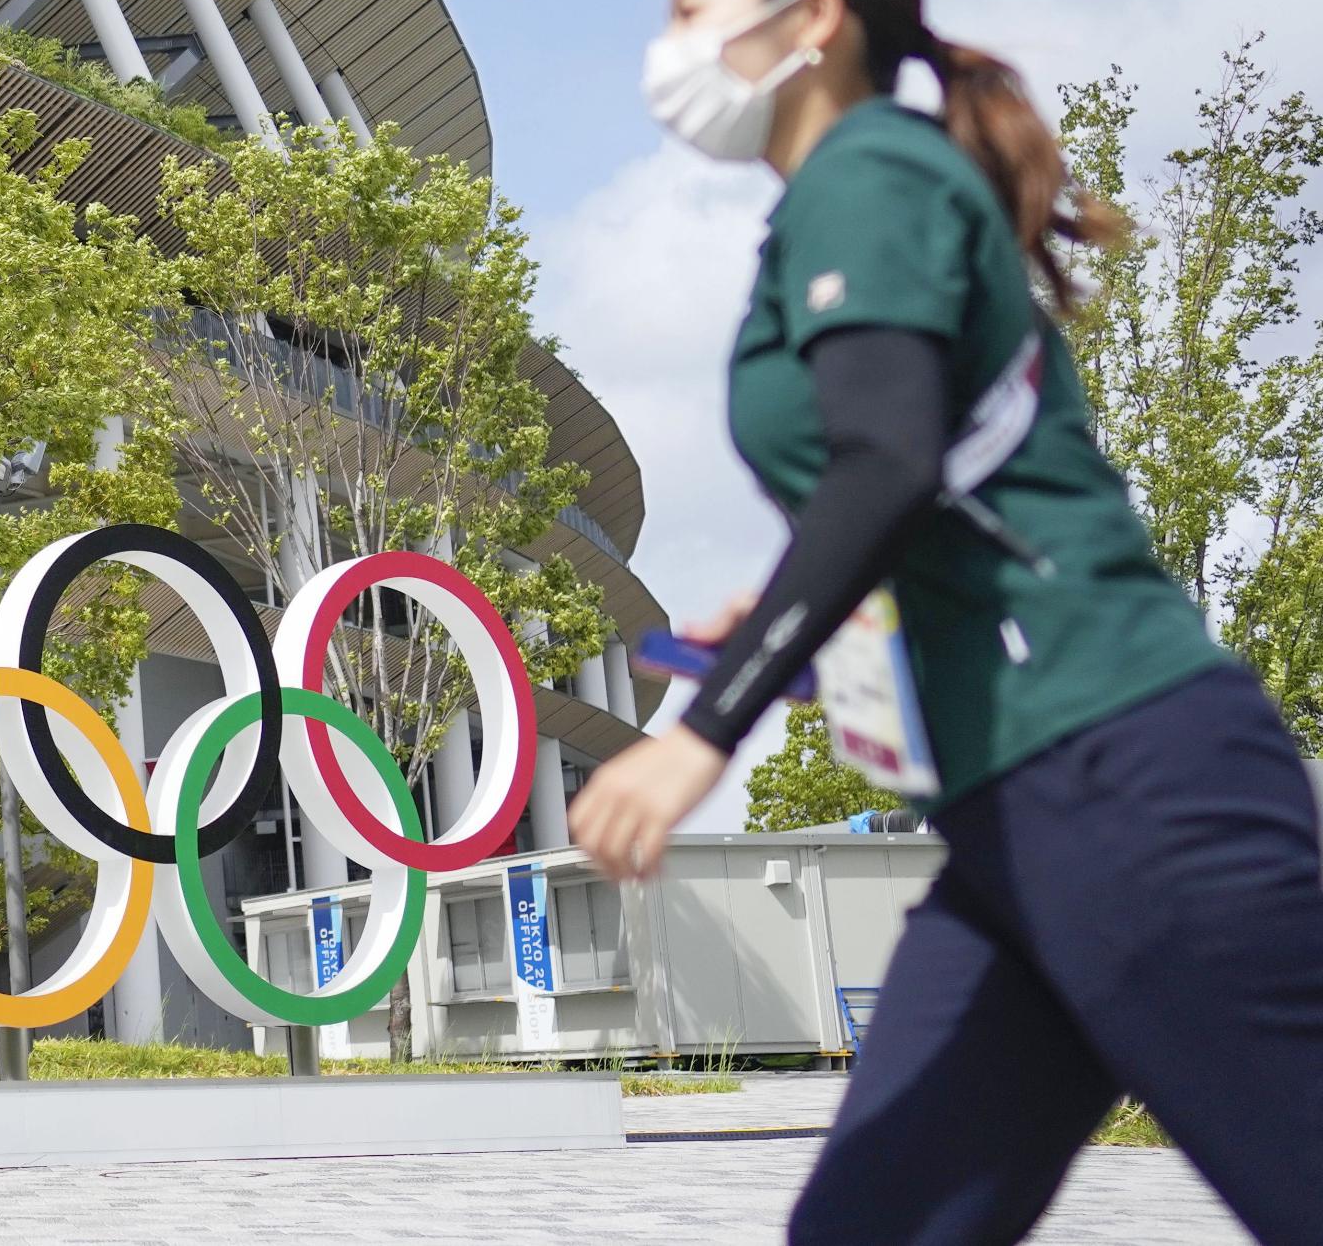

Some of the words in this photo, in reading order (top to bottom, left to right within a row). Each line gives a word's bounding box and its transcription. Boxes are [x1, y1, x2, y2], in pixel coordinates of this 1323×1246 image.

[518, 900, 535, 986] OFFICIAL
[528, 901, 543, 961] TOKYO
[535, 968, 549, 1013] 200
